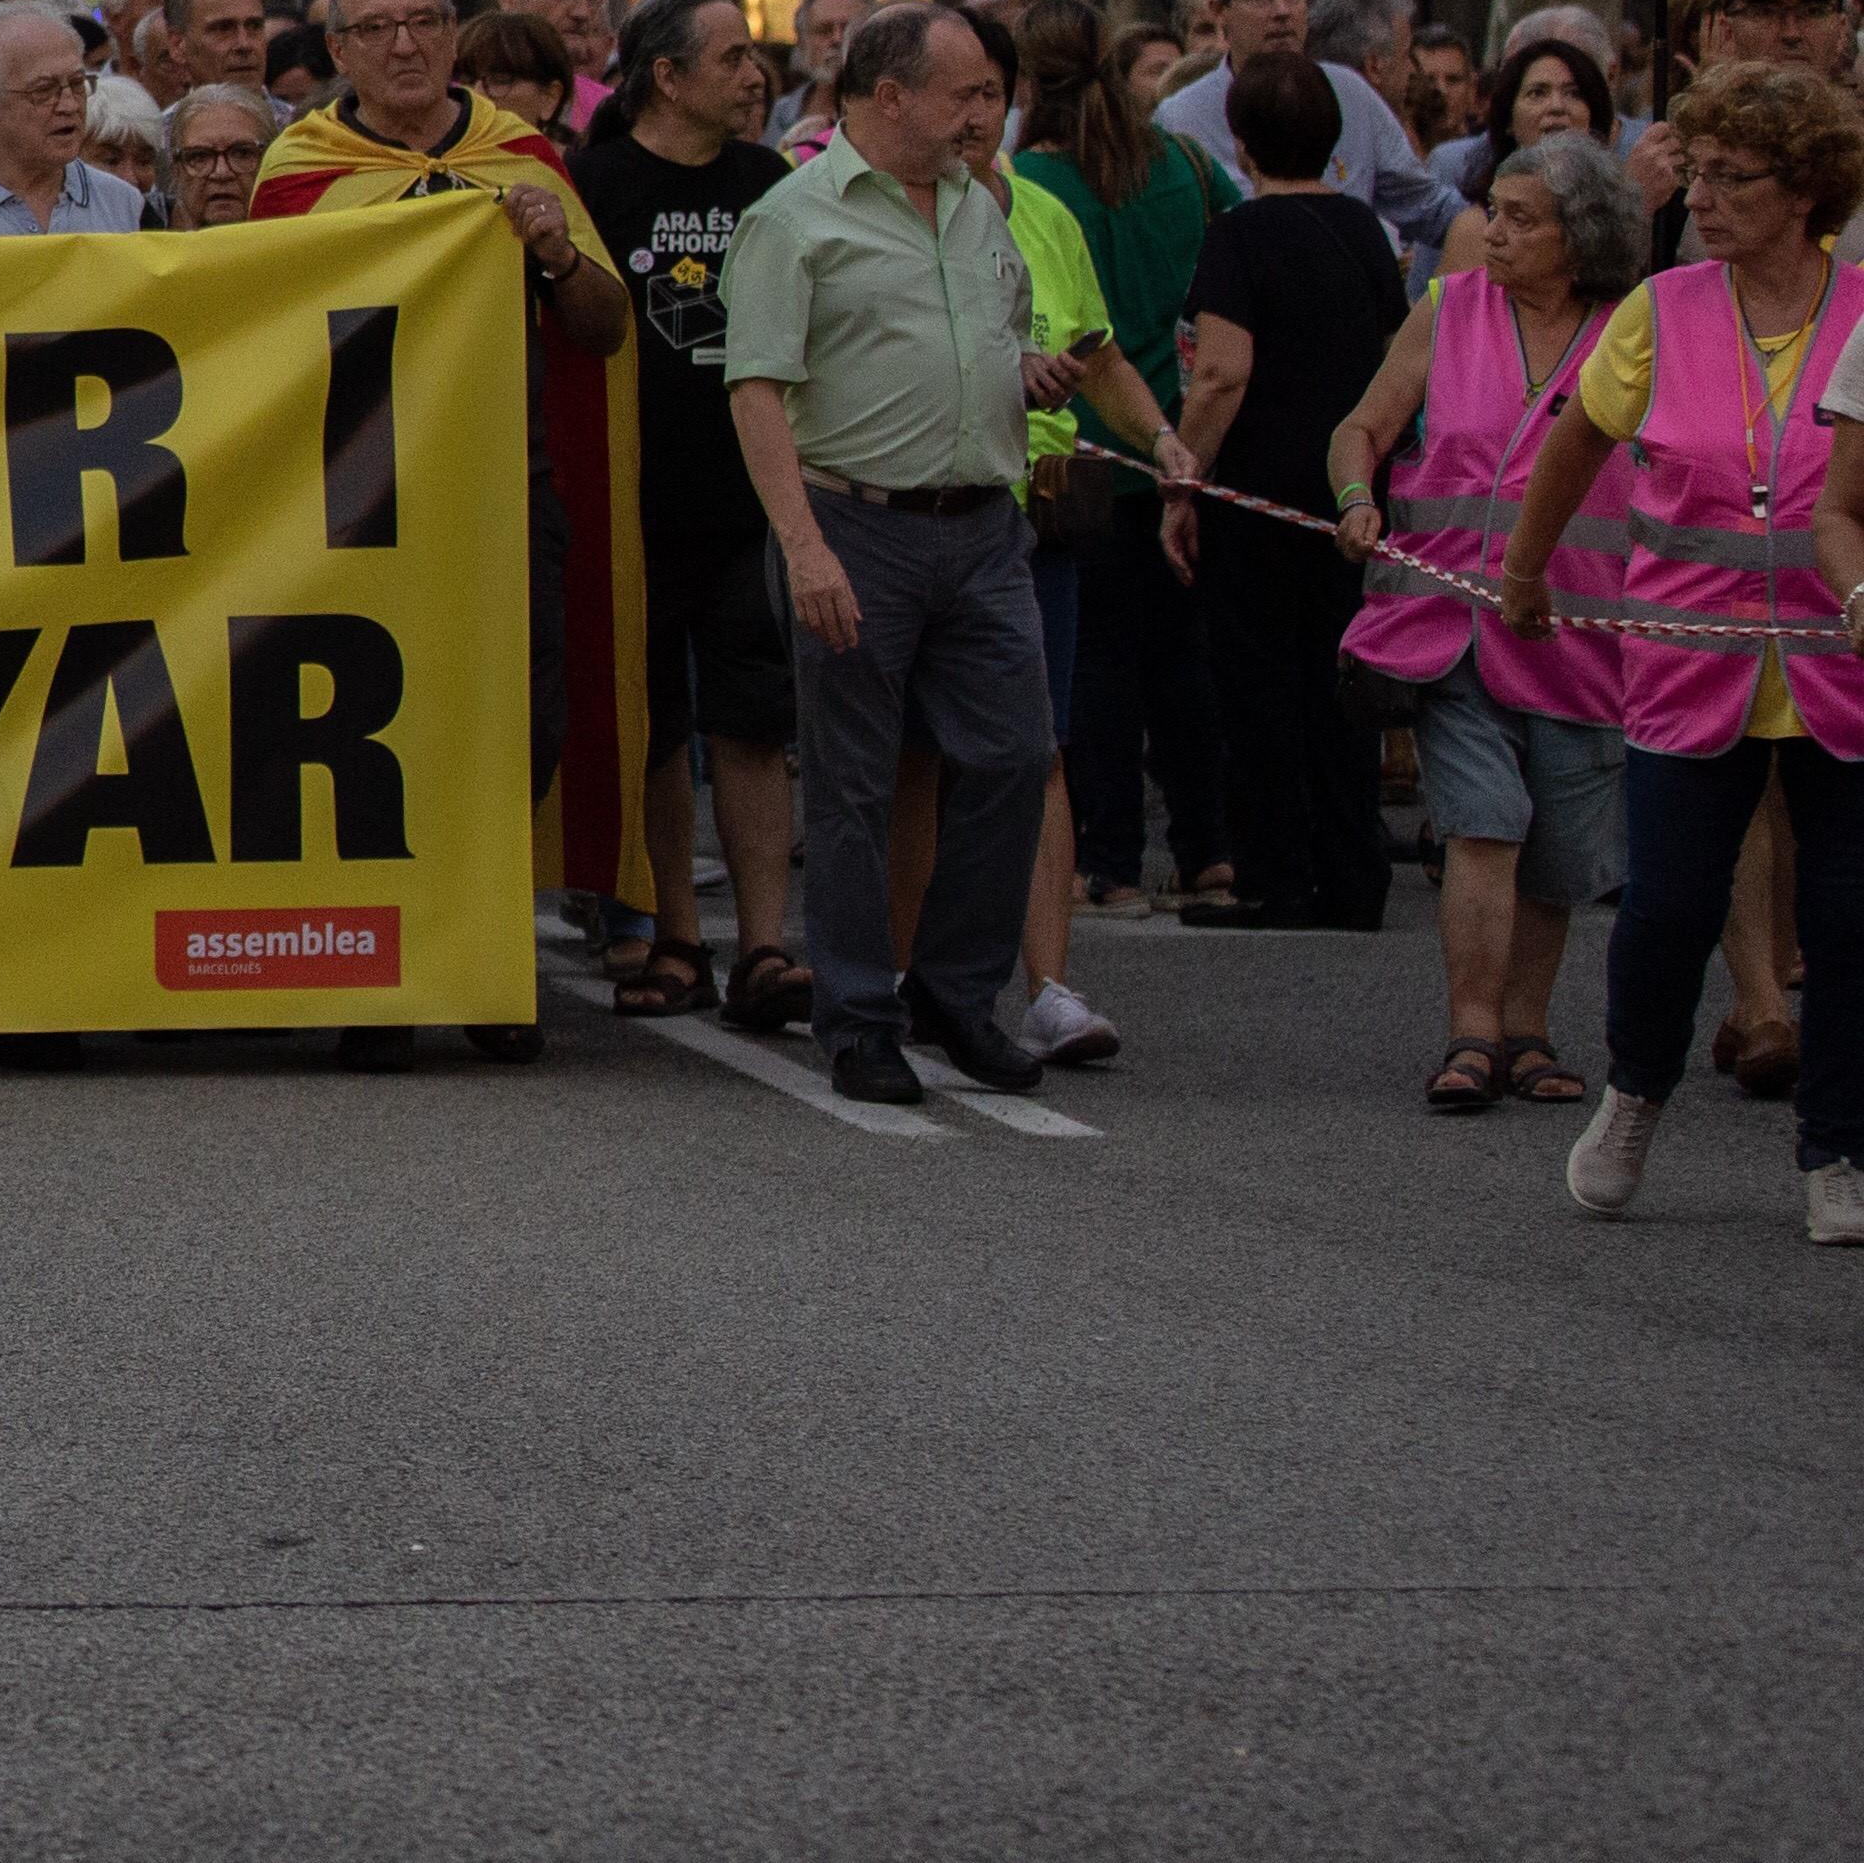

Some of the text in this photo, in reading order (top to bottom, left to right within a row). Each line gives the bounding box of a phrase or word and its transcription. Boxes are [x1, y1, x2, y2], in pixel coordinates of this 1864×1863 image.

[651, 206, 735, 233] ARA ÉS
[650, 233, 732, 254] L'HORA
[325, 306, 399, 548] I
[186, 922, 377, 959] assemblea
